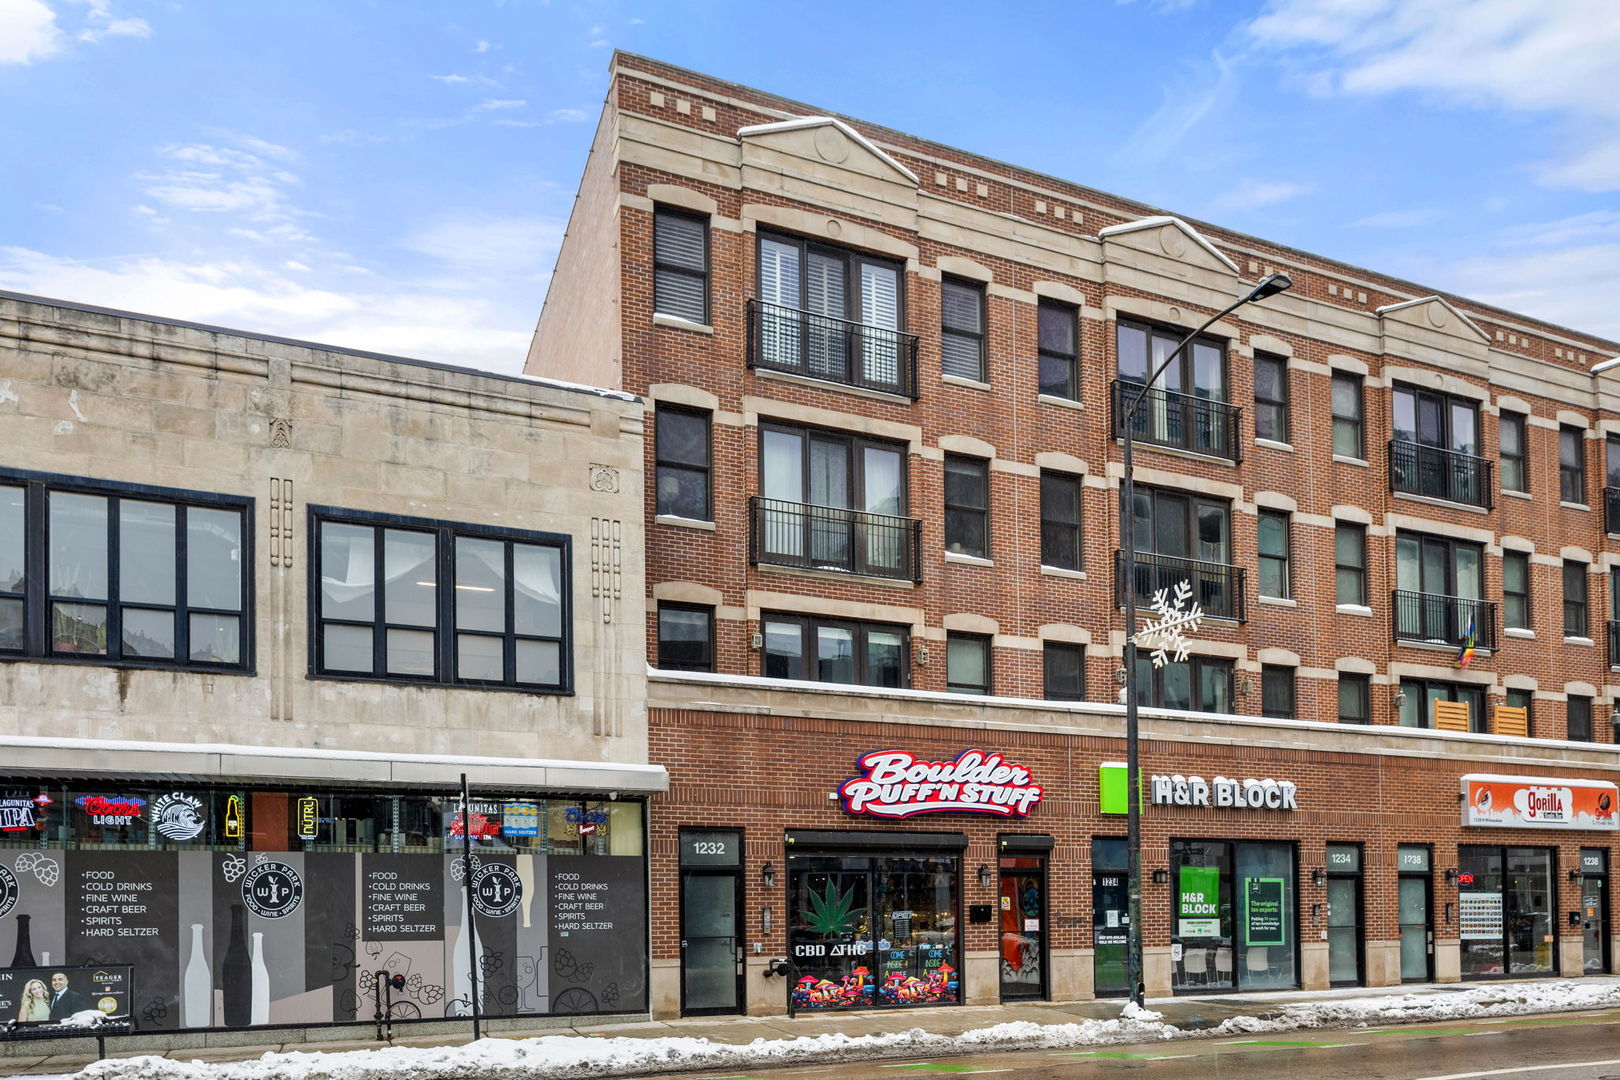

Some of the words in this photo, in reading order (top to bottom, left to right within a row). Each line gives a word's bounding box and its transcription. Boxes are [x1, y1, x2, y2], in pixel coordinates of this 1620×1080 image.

[864, 753, 1030, 785] Boulder
[960, 783, 1040, 813] STUFF
[1152, 779, 1209, 806] H&R
[1213, 782, 1298, 809] BLOCK
[84, 796, 141, 816] Coors
[151, 793, 172, 822] WHITE
[172, 792, 203, 808] CLAW
[453, 803, 498, 814] LAUNITAS
[0, 808, 35, 828] IPA
[93, 815, 132, 825] LIGHT
[693, 842, 725, 854] 1232
[1332, 853, 1351, 863] 1234
[1404, 855, 1421, 864] 1238
[1584, 856, 1599, 866] 1238
[0, 866, 16, 887] ARK
[86, 871, 115, 879] FOOD
[245, 864, 276, 888] WICKER
[281, 866, 300, 887] PARK
[372, 872, 397, 880] FOOD
[471, 865, 500, 888] WICKER
[503, 867, 521, 888] PARK
[86, 882, 113, 891] COLD
[117, 882, 152, 891] DRINKS
[257, 888, 268, 896] W
[282, 888, 289, 896] P
[482, 888, 493, 896] W
[504, 888, 511, 896] P
[86, 894, 108, 902] FINE
[111, 894, 138, 902] WINE
[372, 893, 391, 901] FINE
[394, 893, 418, 901] WINE
[1182, 892, 1204, 902] H&R
[245, 894, 258, 911] FOOD
[282, 895, 300, 914] SPIRITS
[472, 893, 483, 909] FOOD
[504, 895, 520, 913] SPIRITS
[558, 902, 583, 910] CRAFT
[585, 902, 604, 910] BEER
[86, 905, 118, 913] CRAFT
[122, 905, 147, 913] BEER
[1182, 903, 1216, 914] BLOCK
[86, 916, 122, 925] SPIRITS
[372, 914, 404, 922] SPIRITS
[558, 912, 585, 920] SPIRITS
[400, 924, 436, 932] SELTZER
[558, 922, 580, 930] HARD
[582, 922, 613, 930] SELTZER
[86, 928, 114, 936] HARD
[118, 928, 159, 936] SELTZER
[795, 944, 826, 956] CBD
[890, 950, 905, 959] COME
[928, 949, 942, 958] COME
[884, 970, 890, 978] A
[922, 968, 928, 976] A
